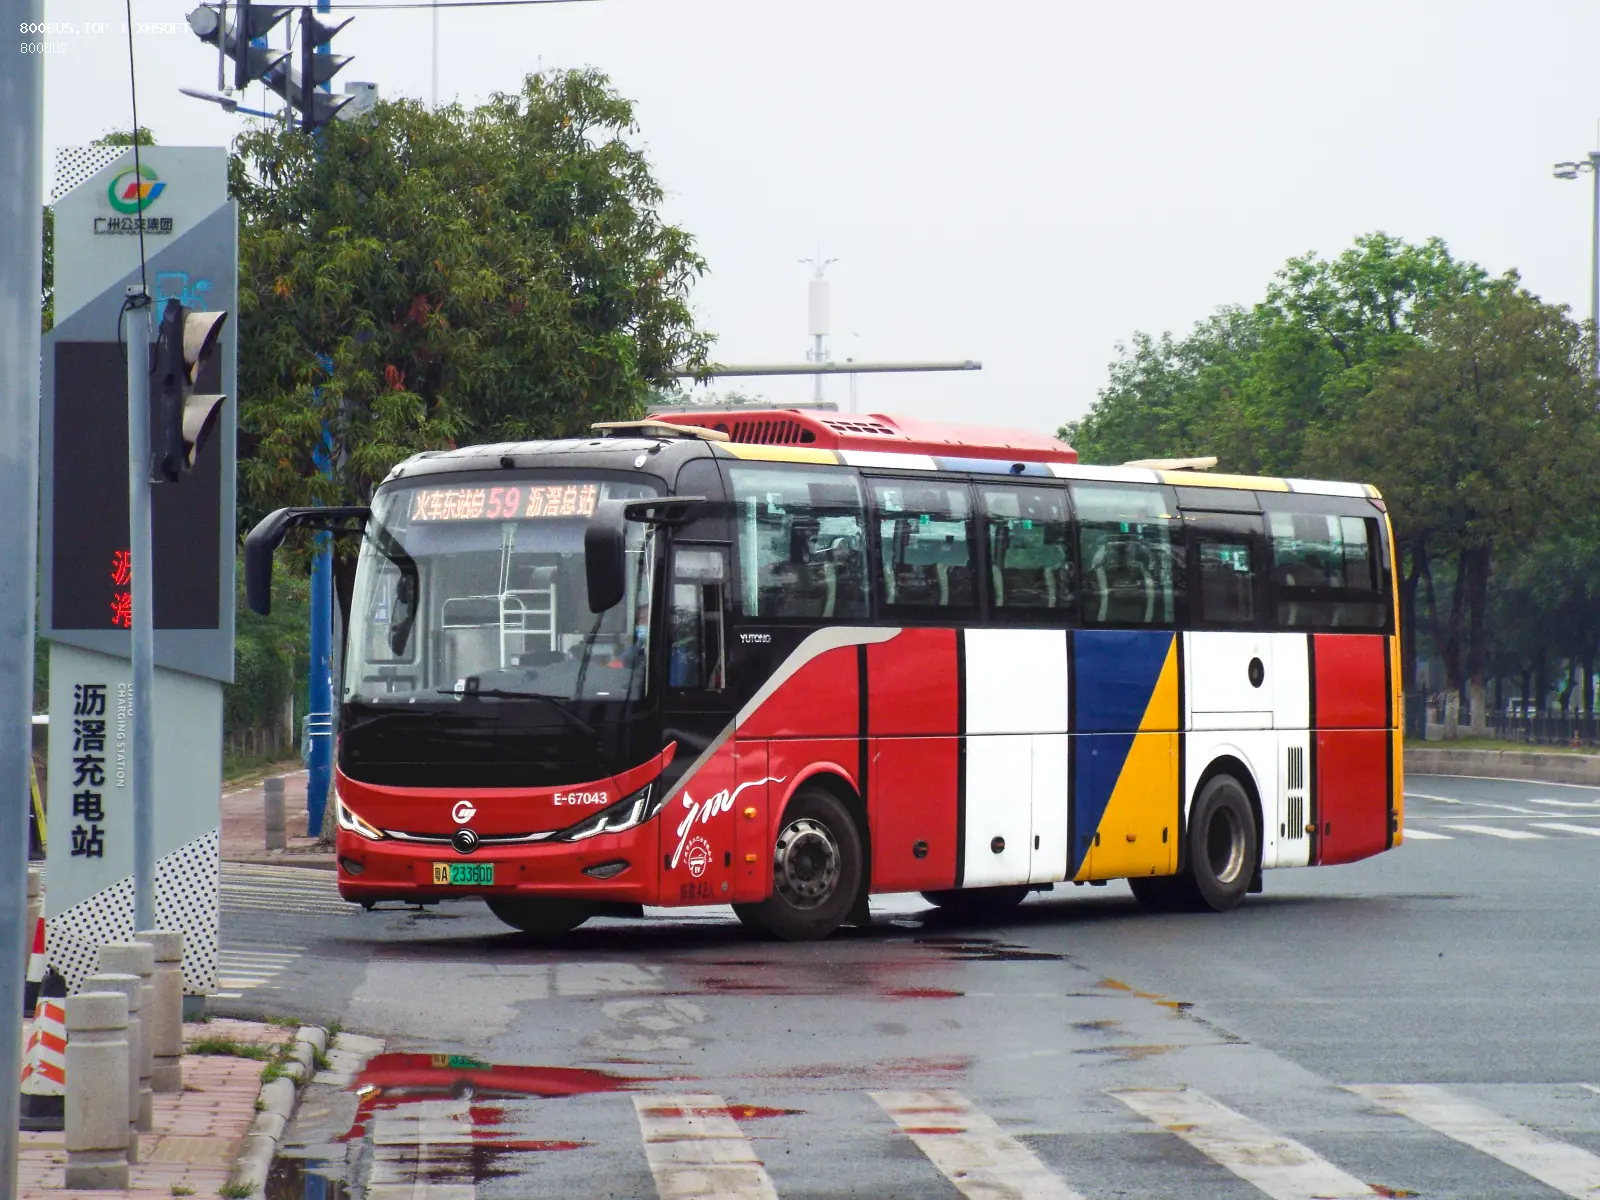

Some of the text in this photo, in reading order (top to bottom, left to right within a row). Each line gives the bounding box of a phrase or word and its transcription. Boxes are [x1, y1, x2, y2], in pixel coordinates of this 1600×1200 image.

[93, 217, 173, 231] 广州公交集团
[486, 486, 522, 519] 59
[739, 633, 772, 644] YUTONG
[116, 683, 126, 788] CHARGING STATION
[71, 683, 107, 859] 沥滘充电站
[553, 792, 608, 806] E-67043
